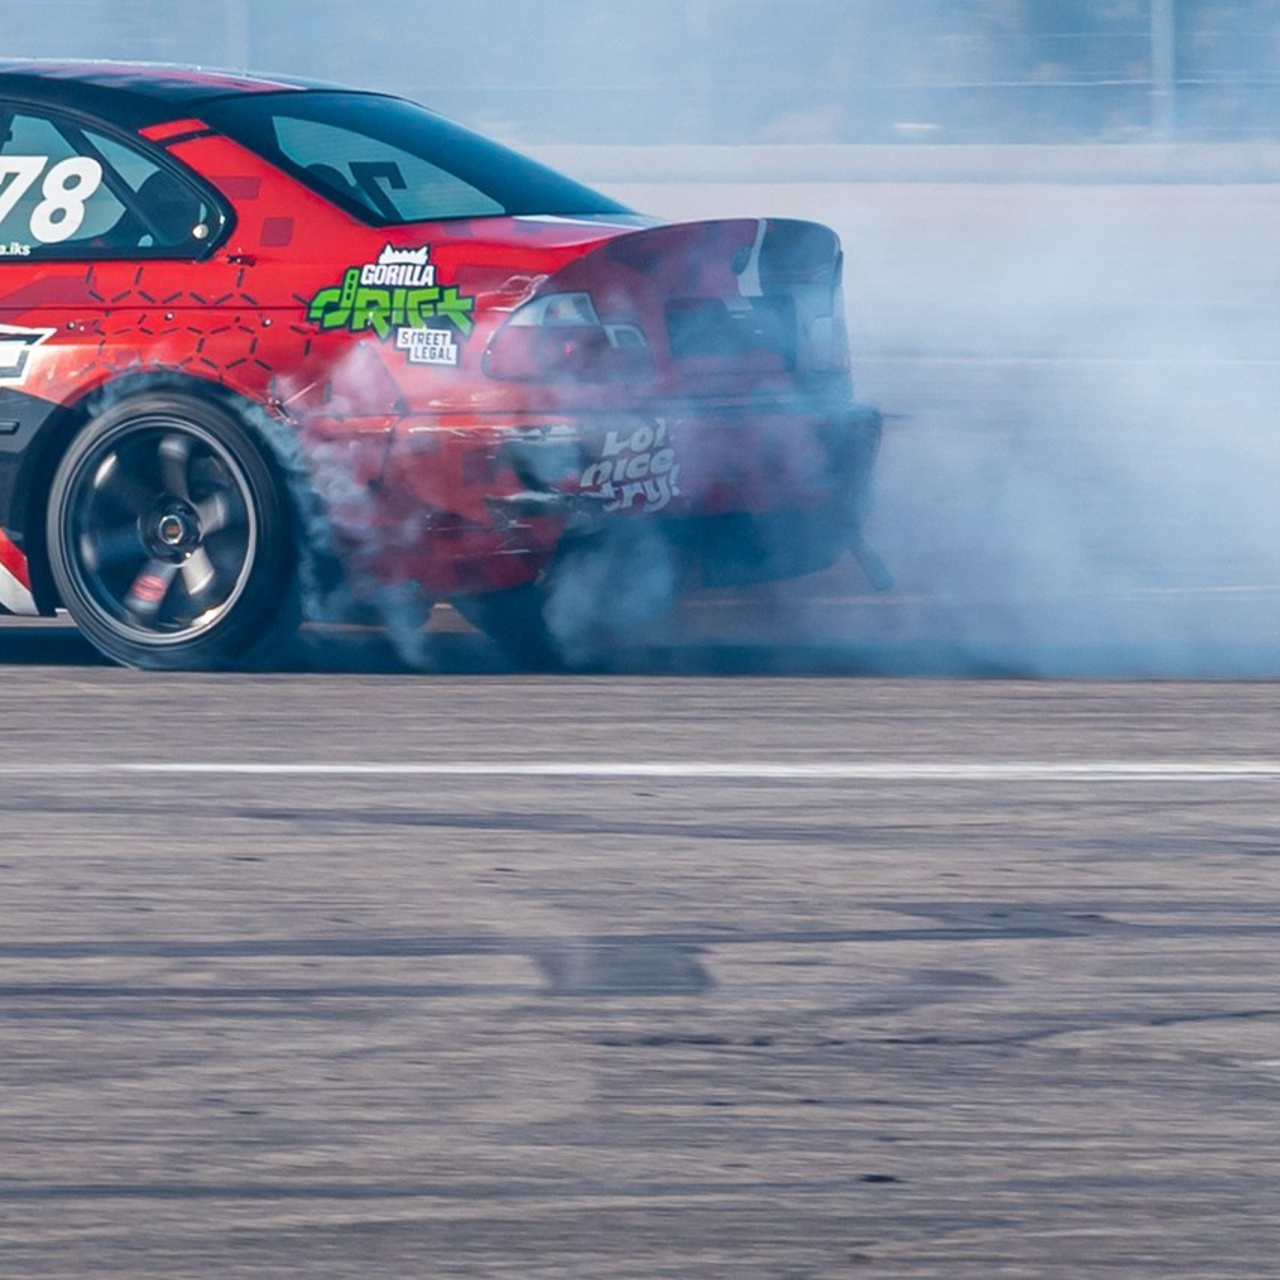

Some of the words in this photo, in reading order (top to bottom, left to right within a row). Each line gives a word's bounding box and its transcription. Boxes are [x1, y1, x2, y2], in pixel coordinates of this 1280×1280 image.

[360, 265, 435, 286] GORILLA
[401, 331, 448, 345] STREET
[413, 346, 452, 361] LEGAL
